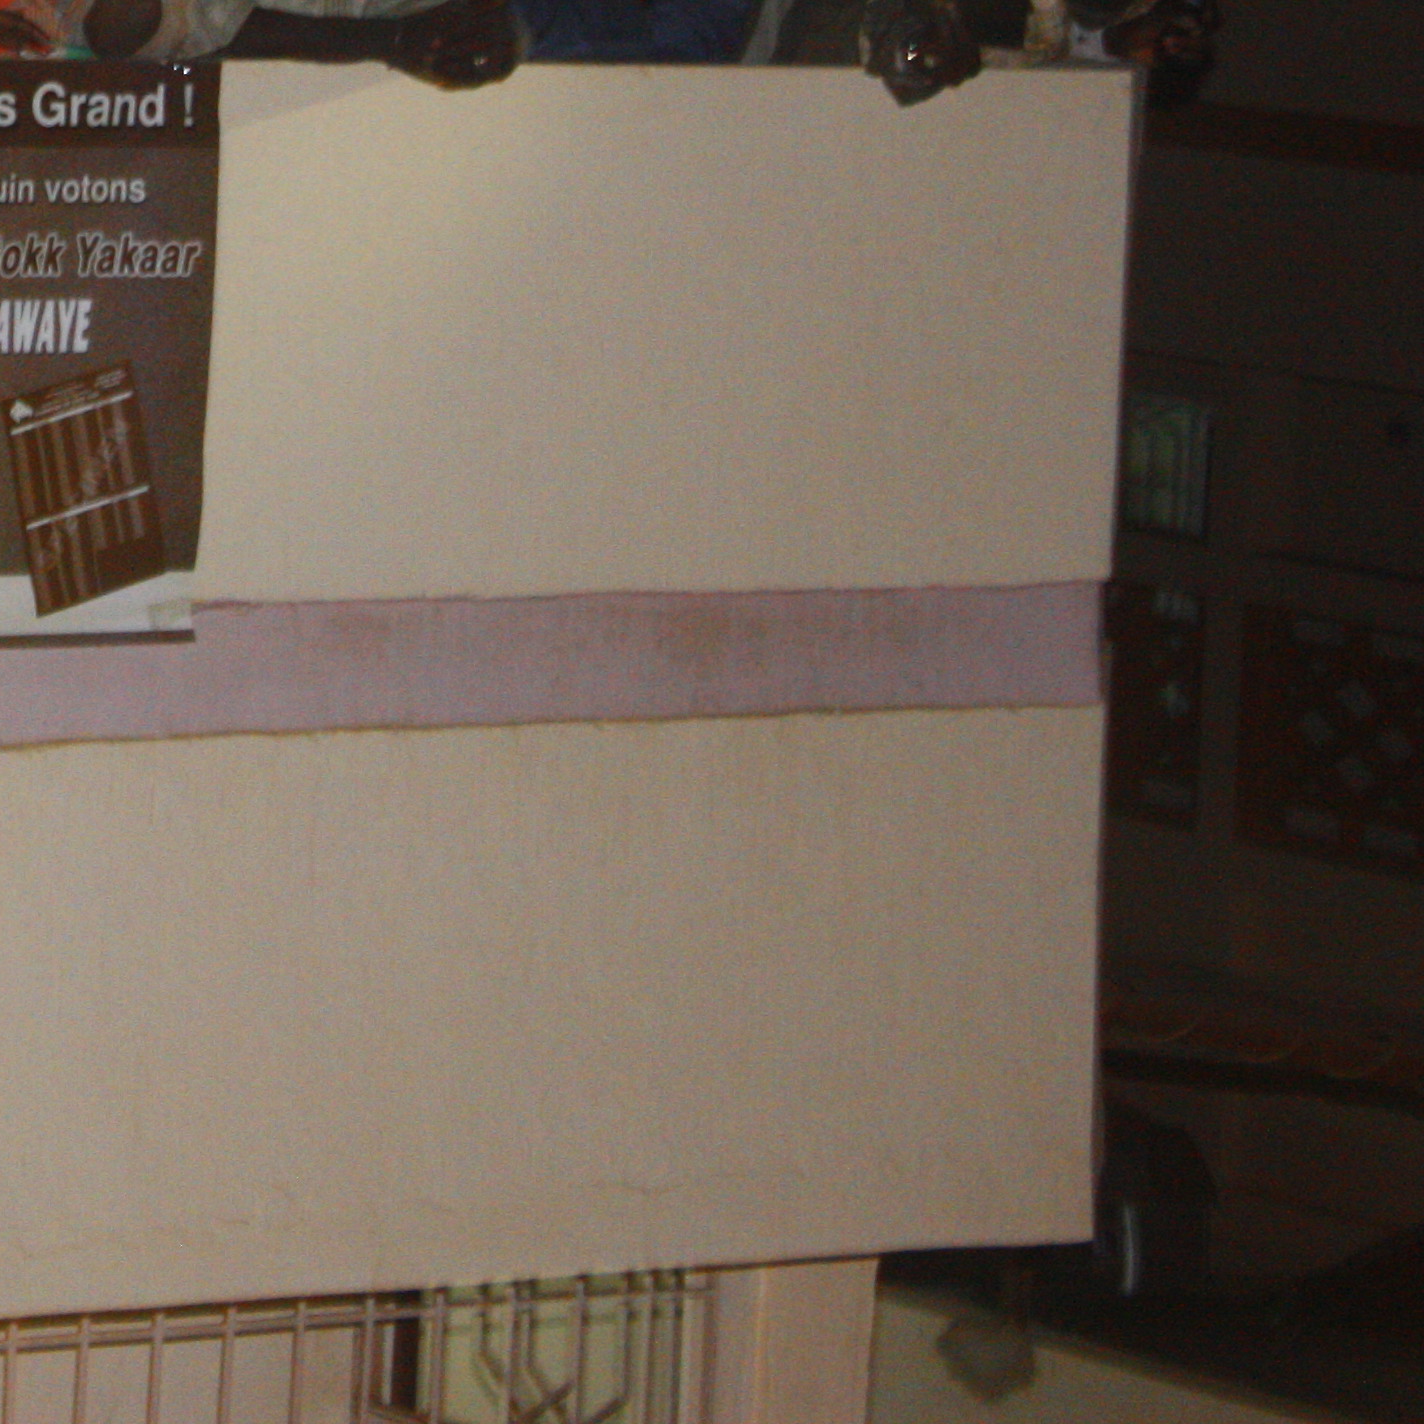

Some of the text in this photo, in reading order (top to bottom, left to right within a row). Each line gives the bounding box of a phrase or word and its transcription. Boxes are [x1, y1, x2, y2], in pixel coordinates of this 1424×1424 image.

[31, 82, 166, 128] Grand
[183, 84, 195, 127] !
[44, 175, 146, 204] votons
[76, 230, 203, 278] Yakaar
